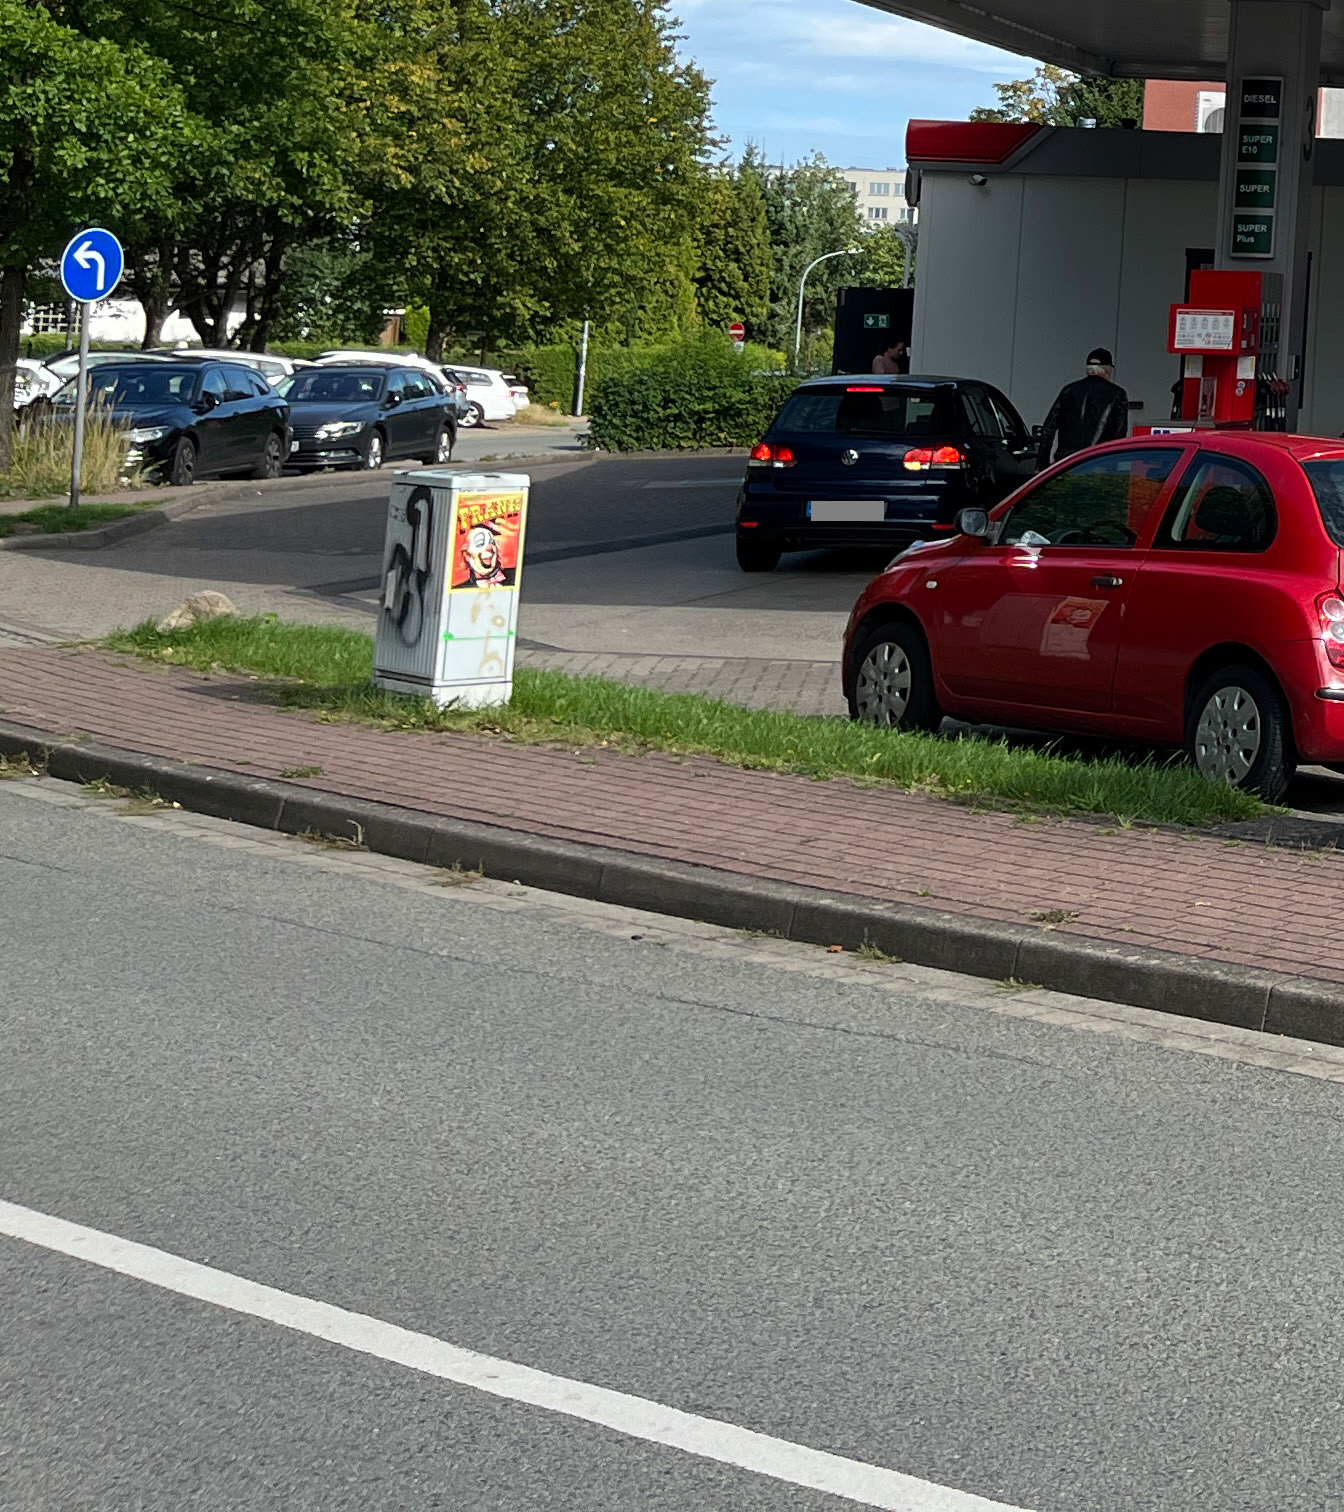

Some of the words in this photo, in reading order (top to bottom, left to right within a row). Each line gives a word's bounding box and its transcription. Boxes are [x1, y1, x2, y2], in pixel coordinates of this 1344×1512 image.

[1243, 94, 1277, 104] DIESEL
[1242, 134, 1273, 144] SUPER
[1242, 145, 1258, 154] E10
[1239, 184, 1270, 193] SUPER
[1237, 223, 1267, 233] SUPER
[1237, 235, 1255, 243] Plus
